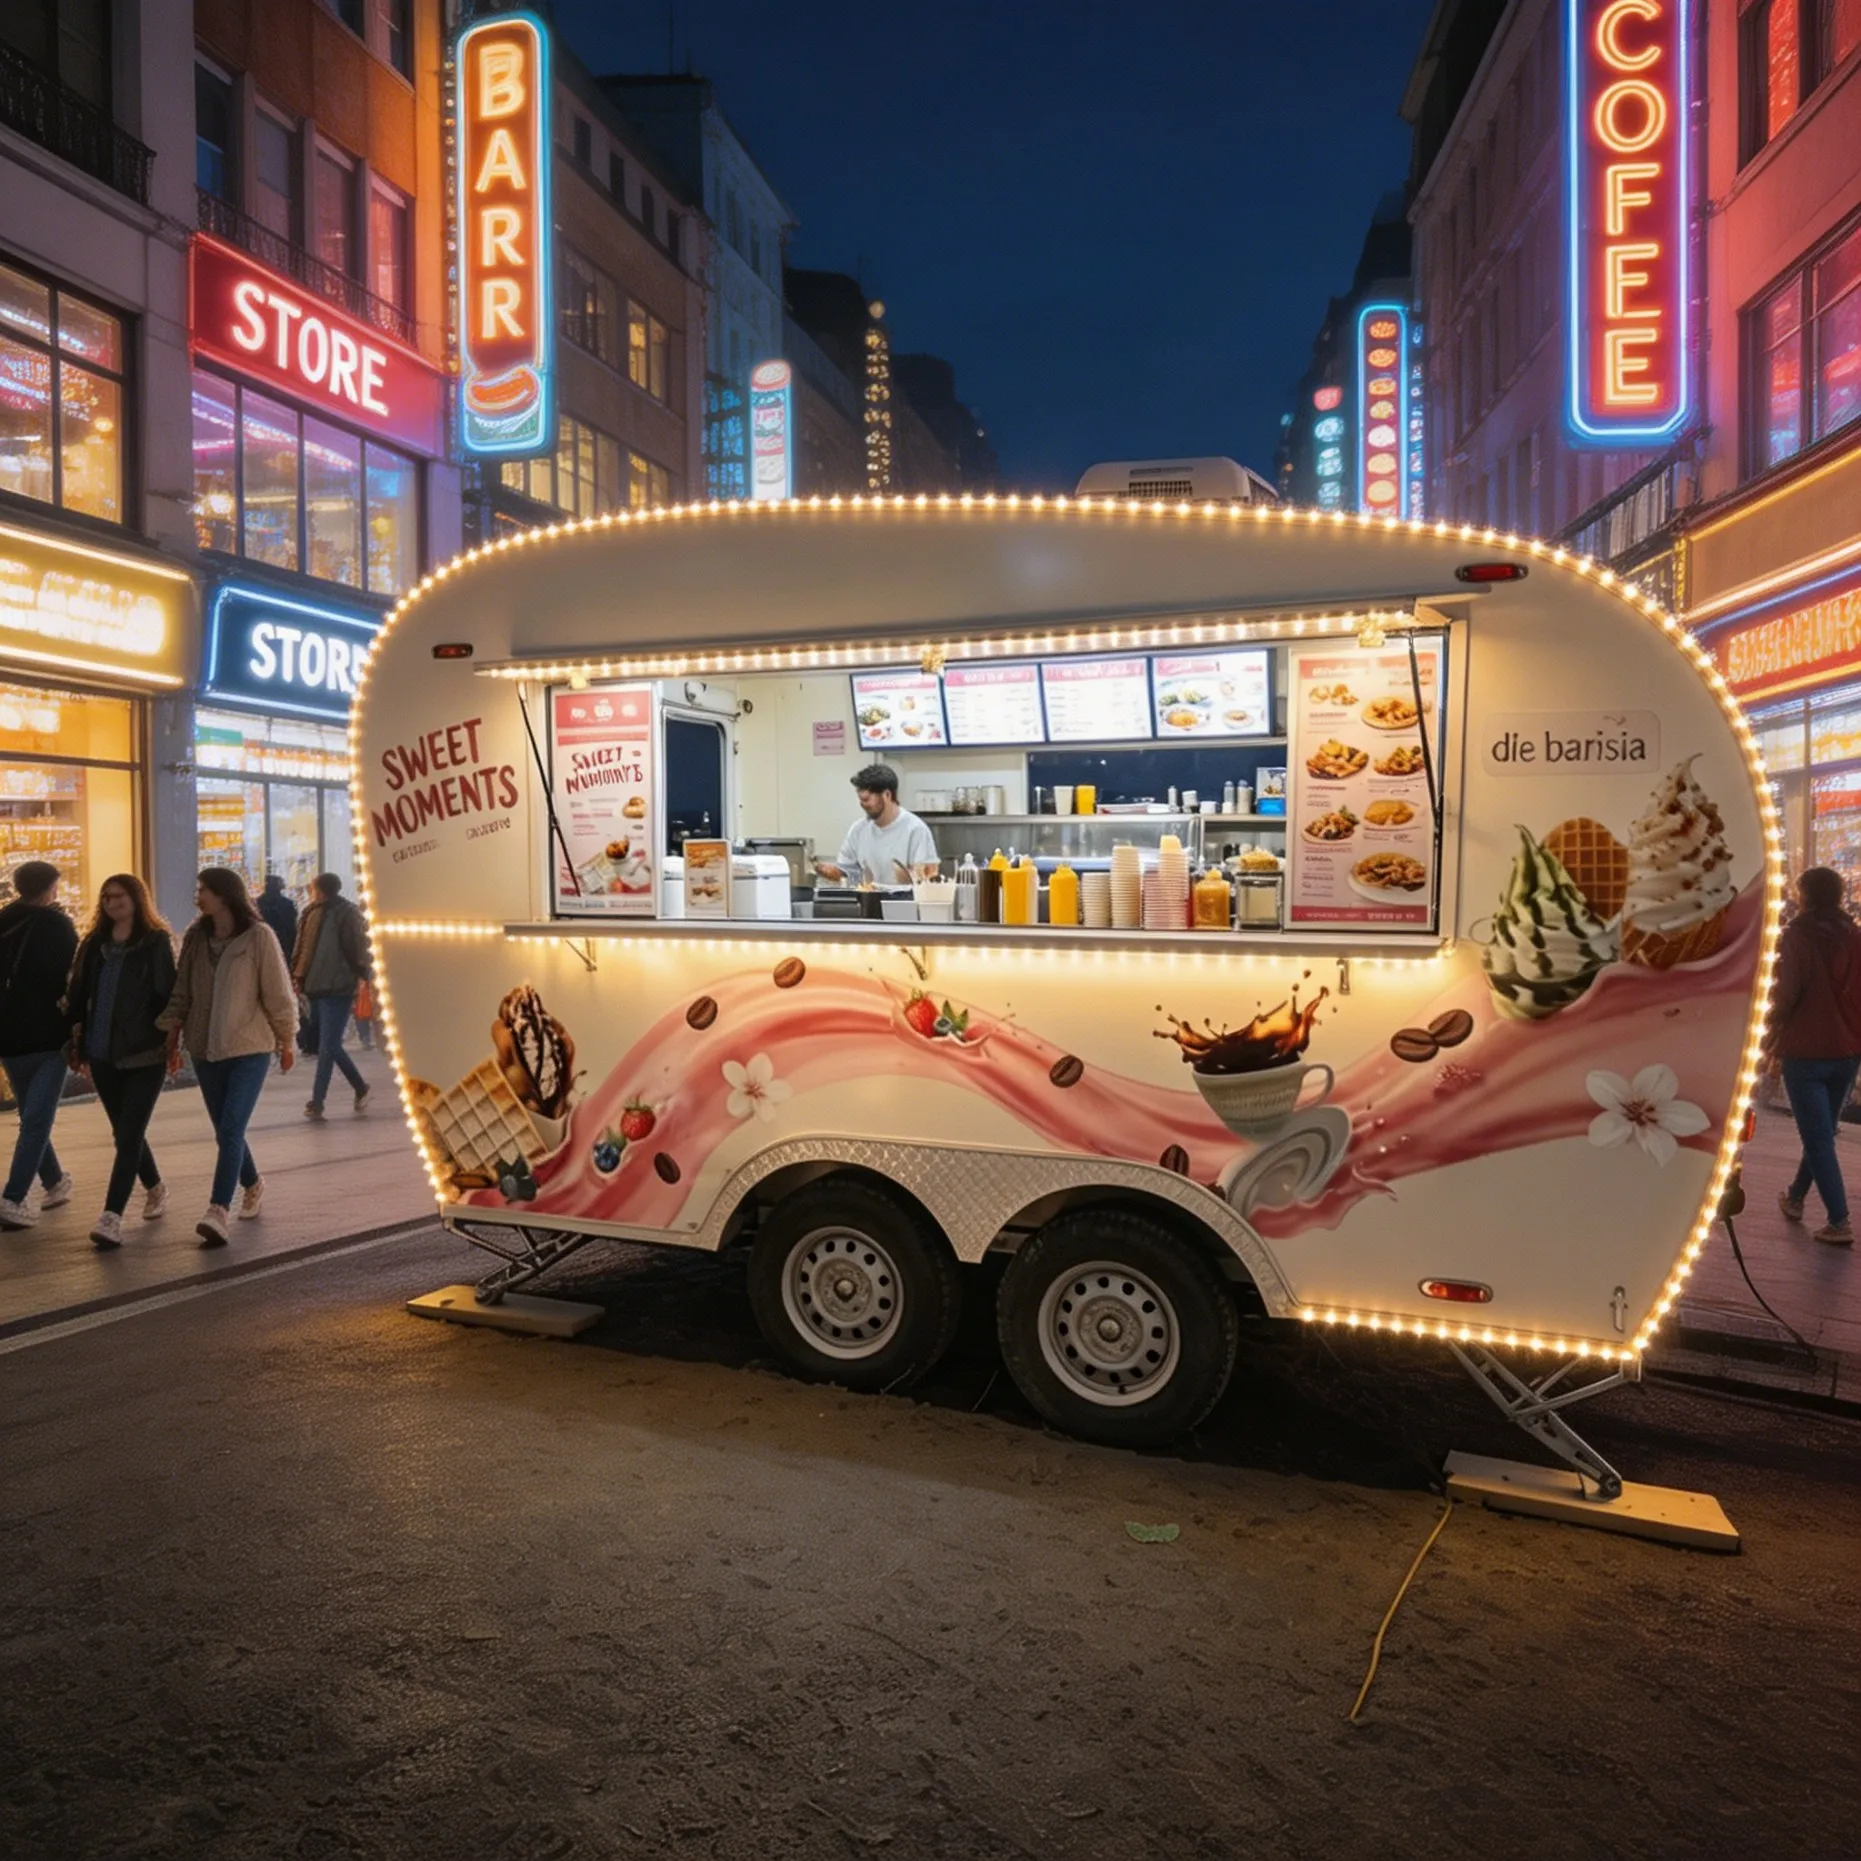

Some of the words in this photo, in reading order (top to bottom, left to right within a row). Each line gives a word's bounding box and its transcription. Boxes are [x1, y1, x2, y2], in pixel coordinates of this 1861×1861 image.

[475, 43, 526, 339] BARR
[232, 281, 389, 417] STORE
[382, 718, 482, 791] SWEET
[1491, 731, 1536, 763] die
[371, 765, 518, 847] MOMENTS
